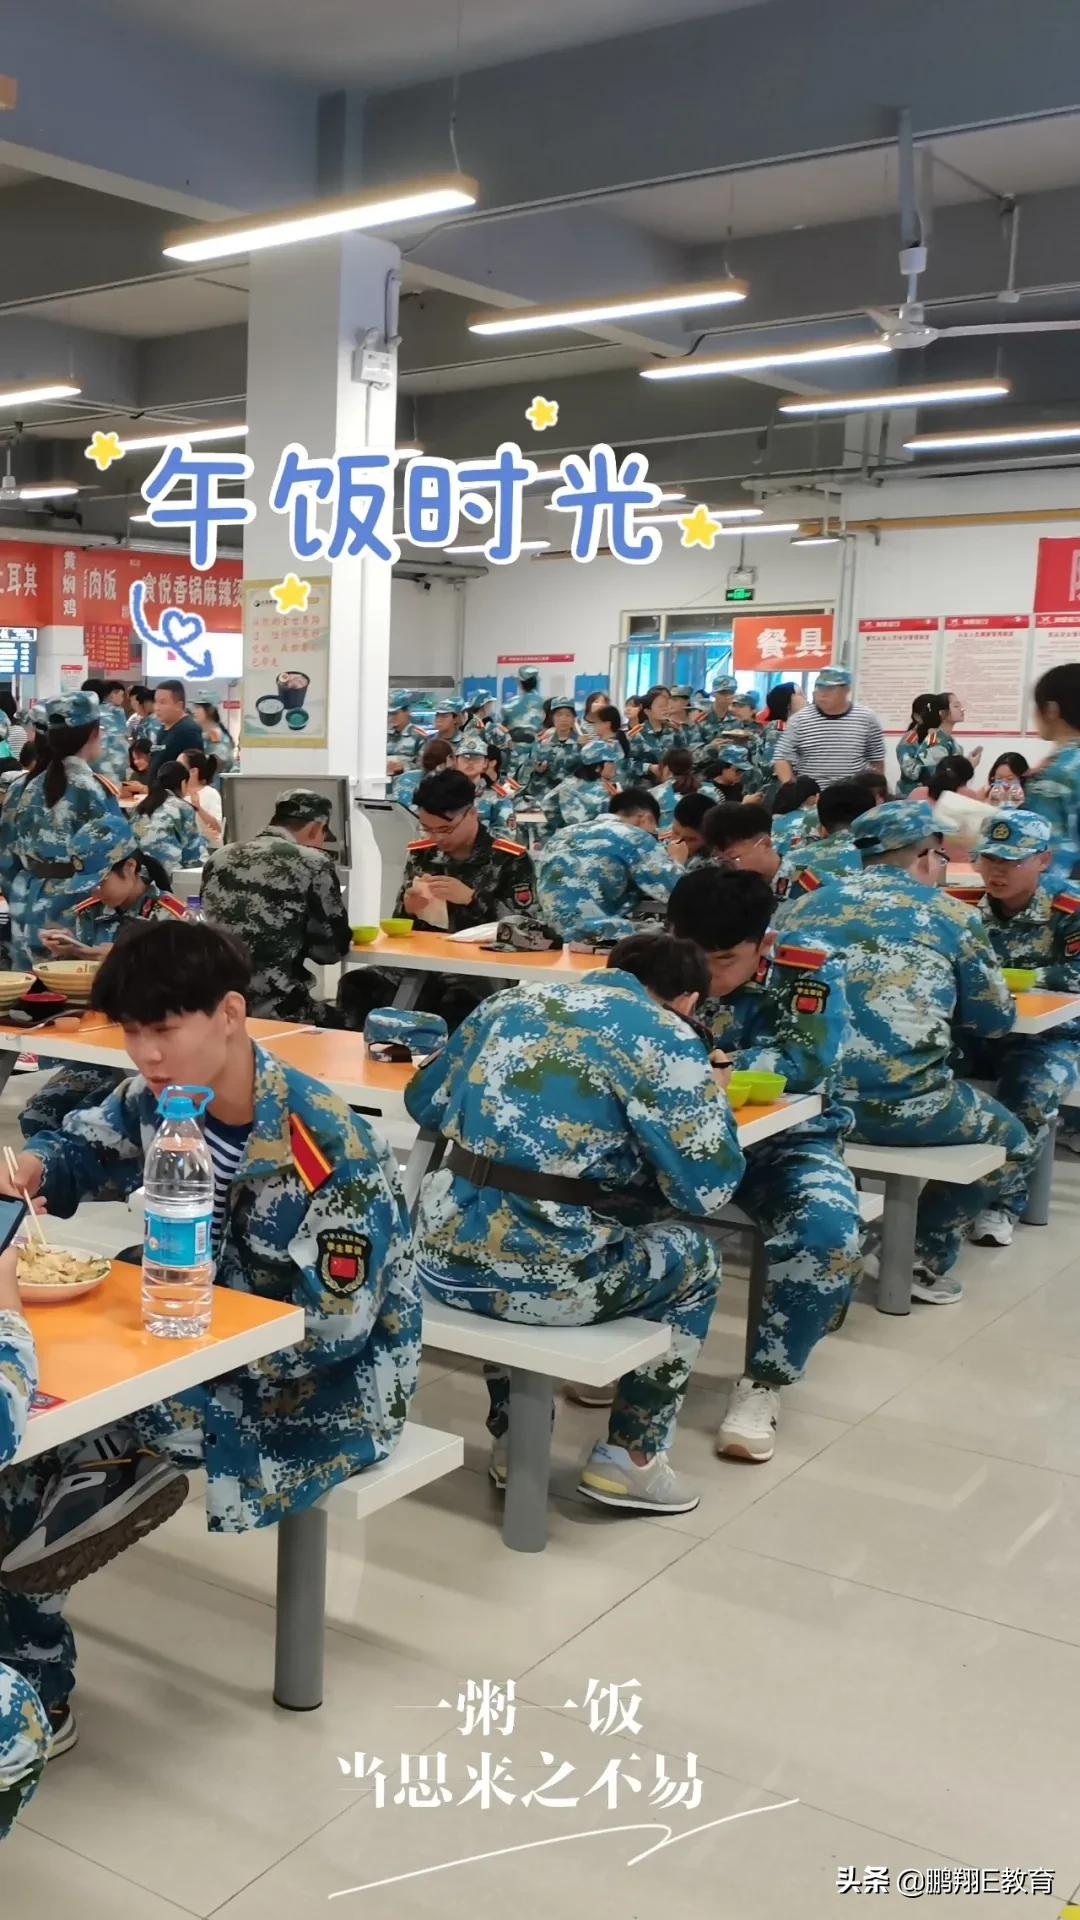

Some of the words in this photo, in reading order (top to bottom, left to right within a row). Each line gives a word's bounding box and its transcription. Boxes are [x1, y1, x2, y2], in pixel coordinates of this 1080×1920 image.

[62, 550, 77, 618] 黄焖鸡
[83, 567, 118, 601] 肉饭
[756, 627, 827, 659] 餐具
